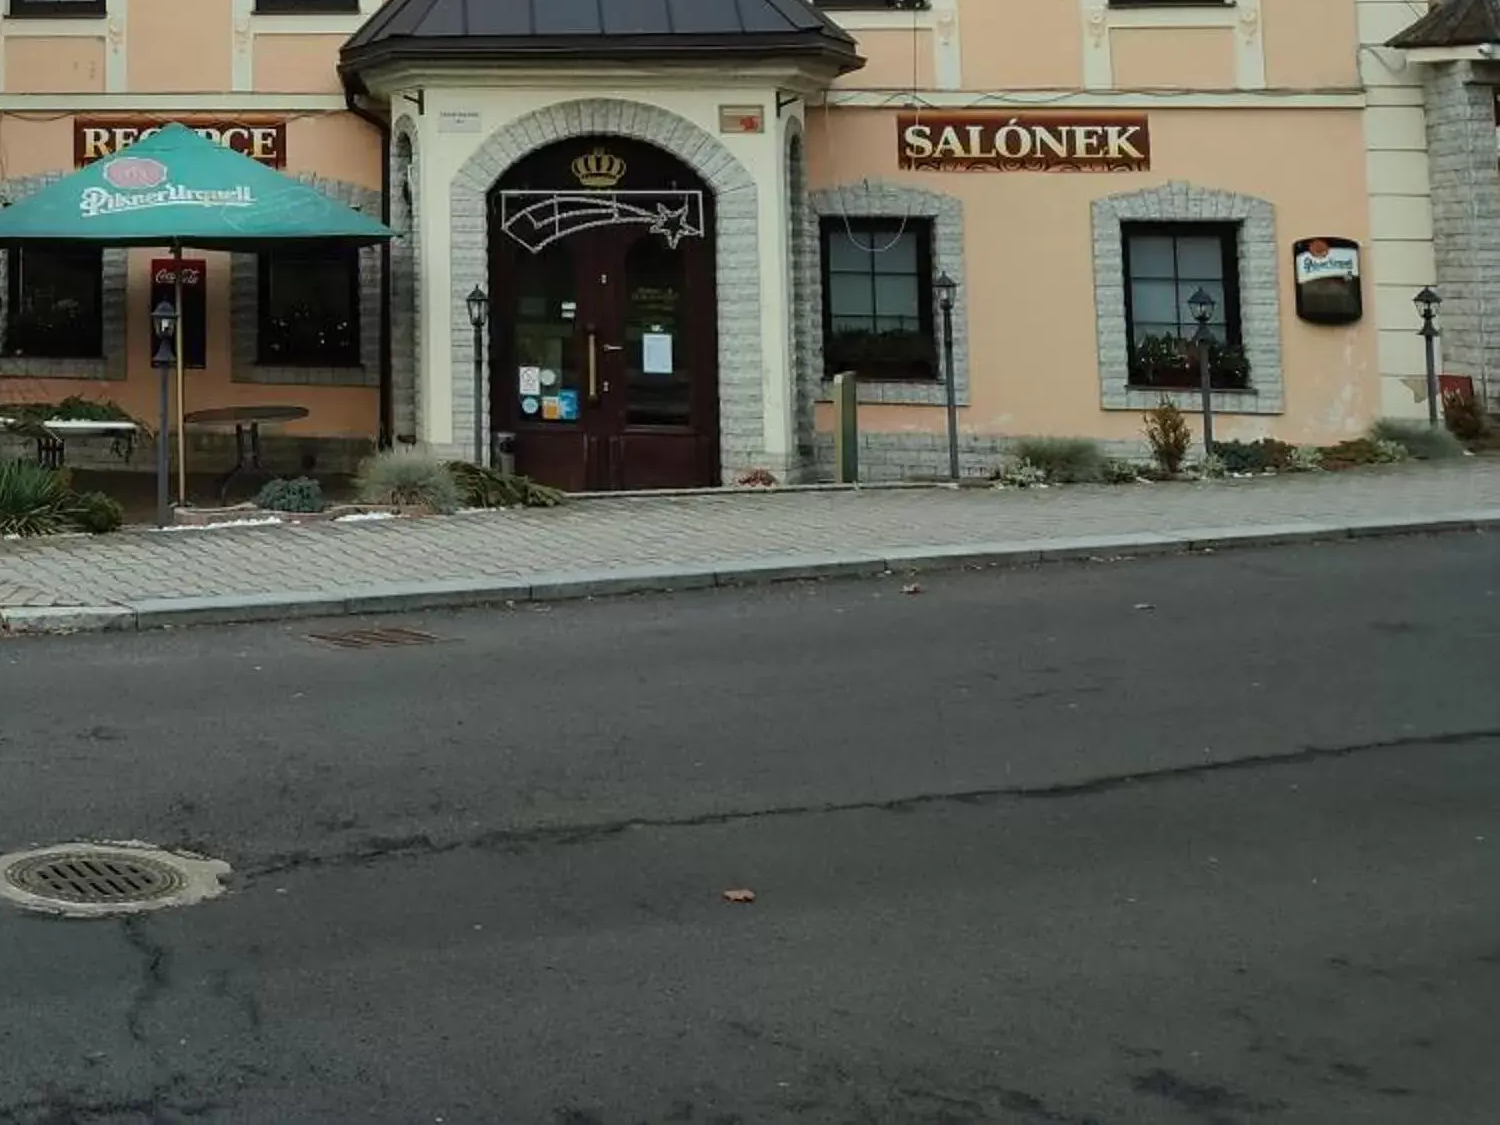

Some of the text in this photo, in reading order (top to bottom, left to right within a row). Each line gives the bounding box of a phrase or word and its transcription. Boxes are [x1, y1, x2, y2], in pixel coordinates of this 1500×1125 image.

[904, 118, 1145, 158] SALÓNEK
[79, 183, 257, 217] Pilsner Urquell
